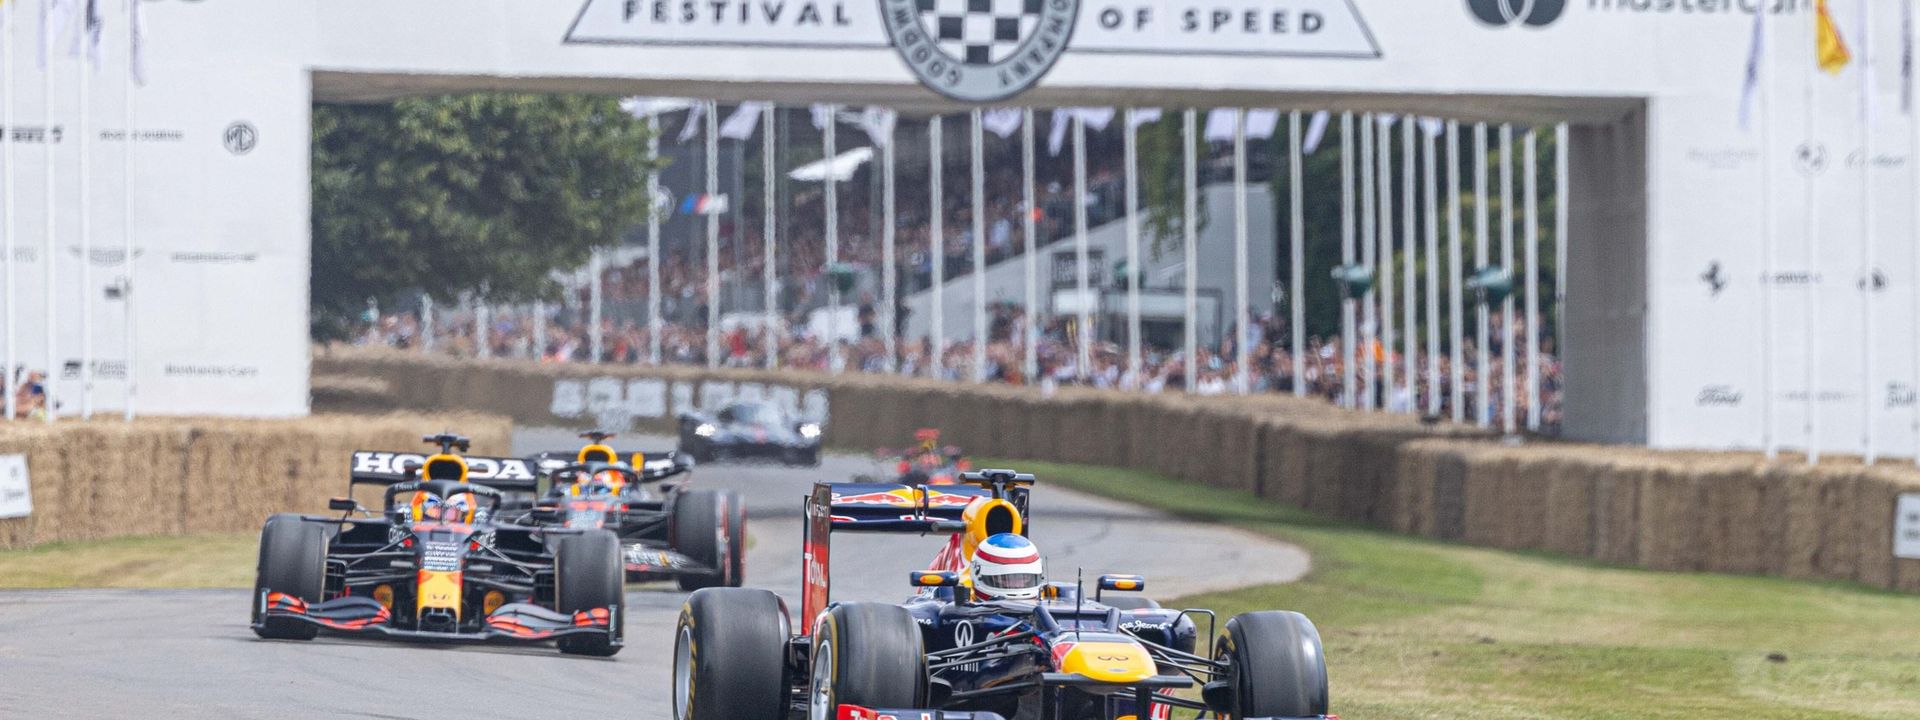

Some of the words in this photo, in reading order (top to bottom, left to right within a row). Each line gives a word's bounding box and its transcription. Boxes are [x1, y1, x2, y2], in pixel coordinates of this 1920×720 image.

[621, 0, 852, 26] FESTIVAL
[1098, 7, 1152, 32] OF
[1181, 9, 1325, 34] SPEED
[354, 452, 535, 480] HODA
